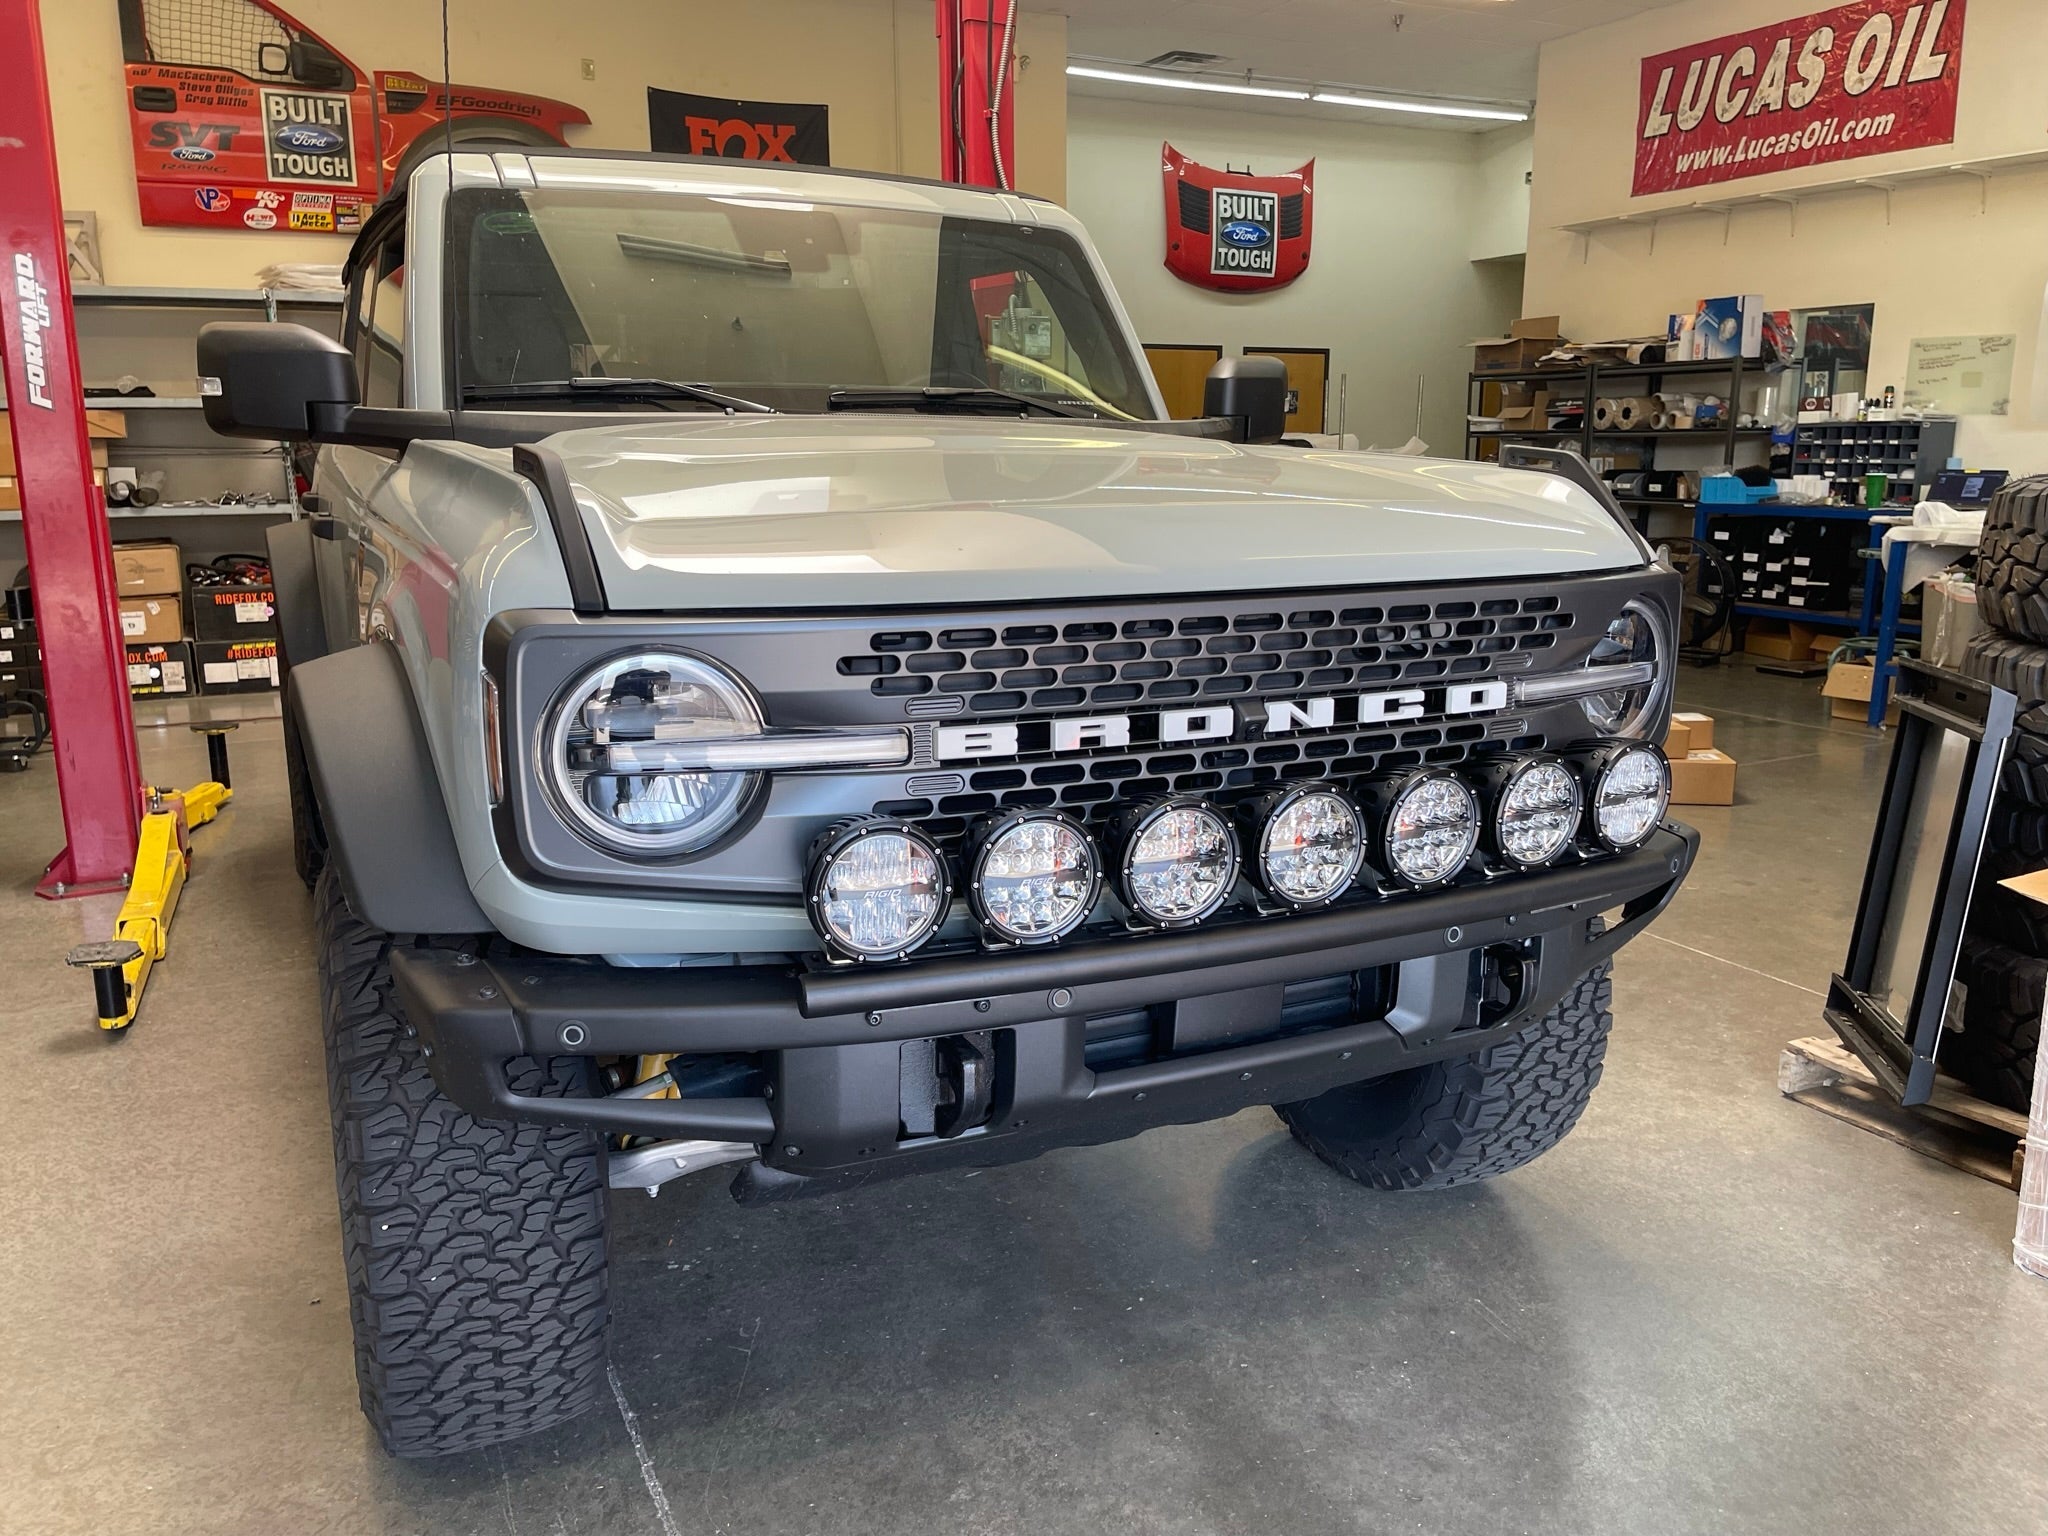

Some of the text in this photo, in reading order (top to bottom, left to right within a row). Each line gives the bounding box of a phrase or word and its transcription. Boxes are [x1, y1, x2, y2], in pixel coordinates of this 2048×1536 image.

[158, 69, 233, 83] MacCachren
[1643, 0, 1949, 138] LUCAS OIL
[179, 82, 211, 93] Steve
[185, 94, 213, 105] Greg
[435, 95, 542, 117] BFGoodrich
[269, 96, 344, 125] BUILT
[148, 120, 240, 151] SVT
[292, 130, 328, 147] Ford
[685, 115, 798, 164] FOX
[1675, 112, 1895, 174] www.LucasOil.com
[180, 149, 207, 160] Ford
[273, 153, 349, 178] TOUGH
[302, 213, 327, 221] Auto
[1218, 195, 1274, 222] BUILT
[300, 219, 331, 228] Meter
[1233, 227, 1259, 242] Ford
[1218, 248, 1272, 269] TOUGH
[35, 282, 50, 328] LIFT
[933, 681, 1508, 760] BRONCO
[863, 888, 903, 899] RIGID
